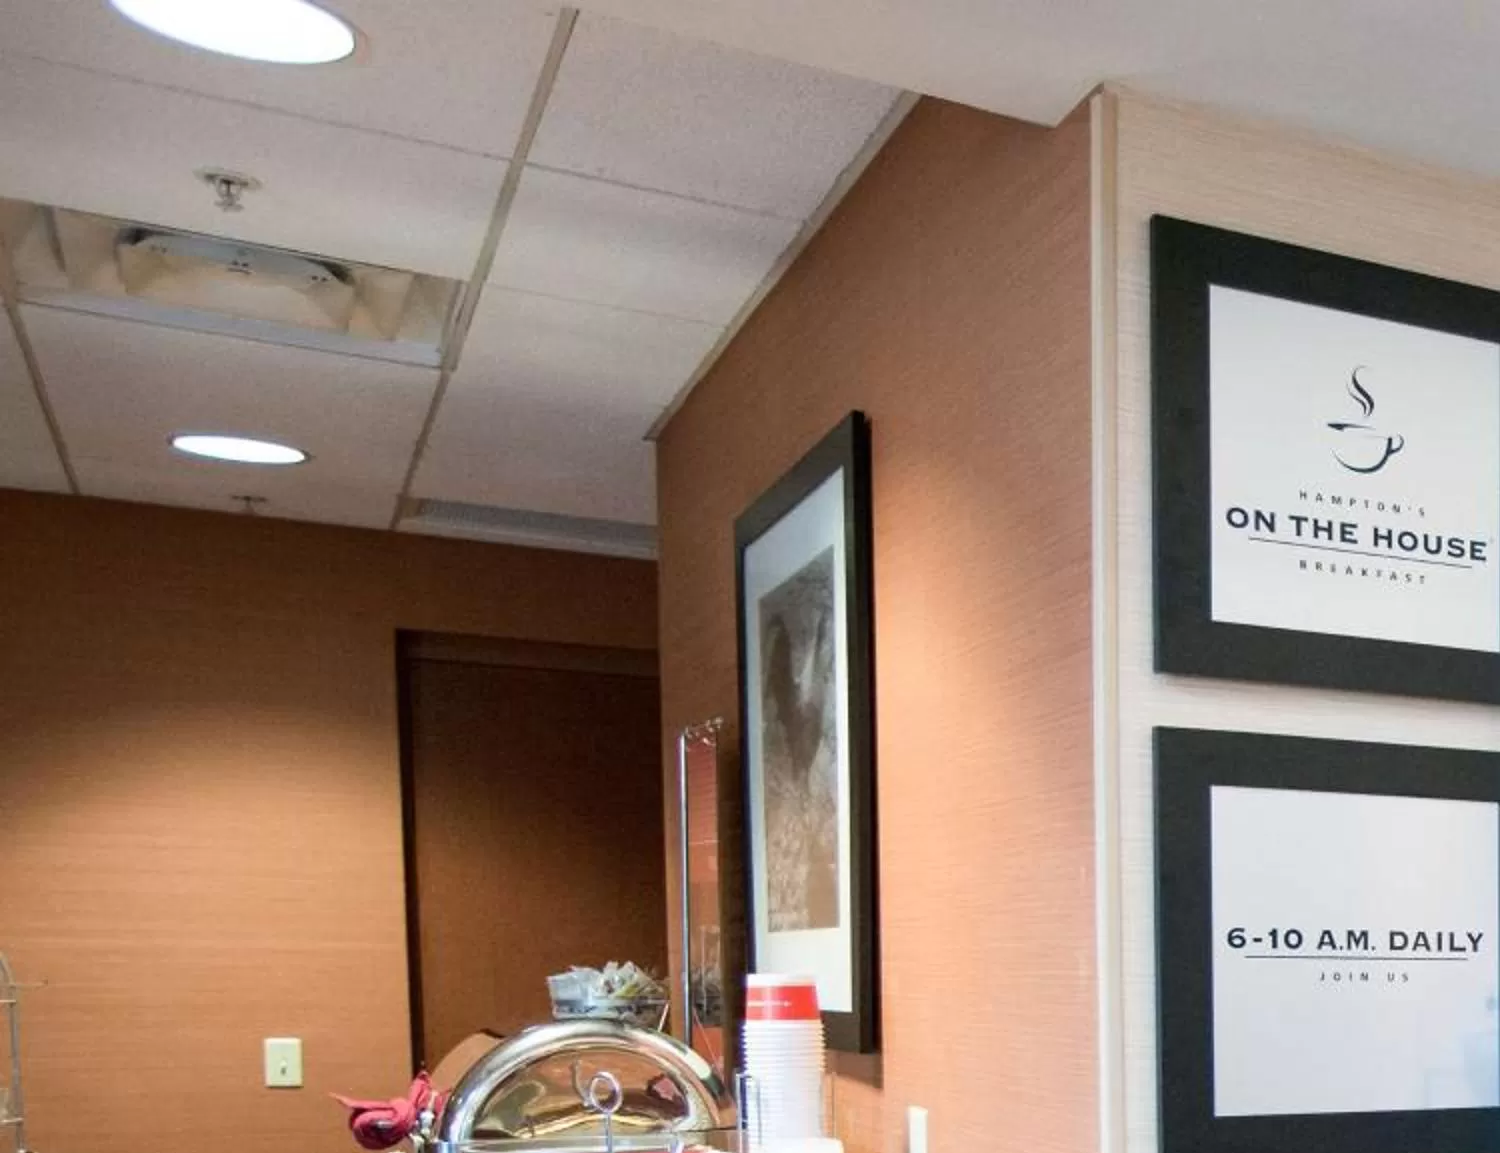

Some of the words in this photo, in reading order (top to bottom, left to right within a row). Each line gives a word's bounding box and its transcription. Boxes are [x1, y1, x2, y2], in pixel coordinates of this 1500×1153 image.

[1300, 490, 1425, 517] HAMPTON'S
[1226, 507, 1276, 533] ON
[1288, 514, 1359, 545] THE
[1372, 526, 1488, 562] HOUSE
[1300, 559, 1426, 584] BREAKFAST
[1226, 927, 1304, 950] 6-10
[1316, 929, 1377, 951] A.M.
[1388, 930, 1484, 953] DAILY
[1319, 971, 1369, 983] JOIN
[1387, 971, 1410, 983] US
